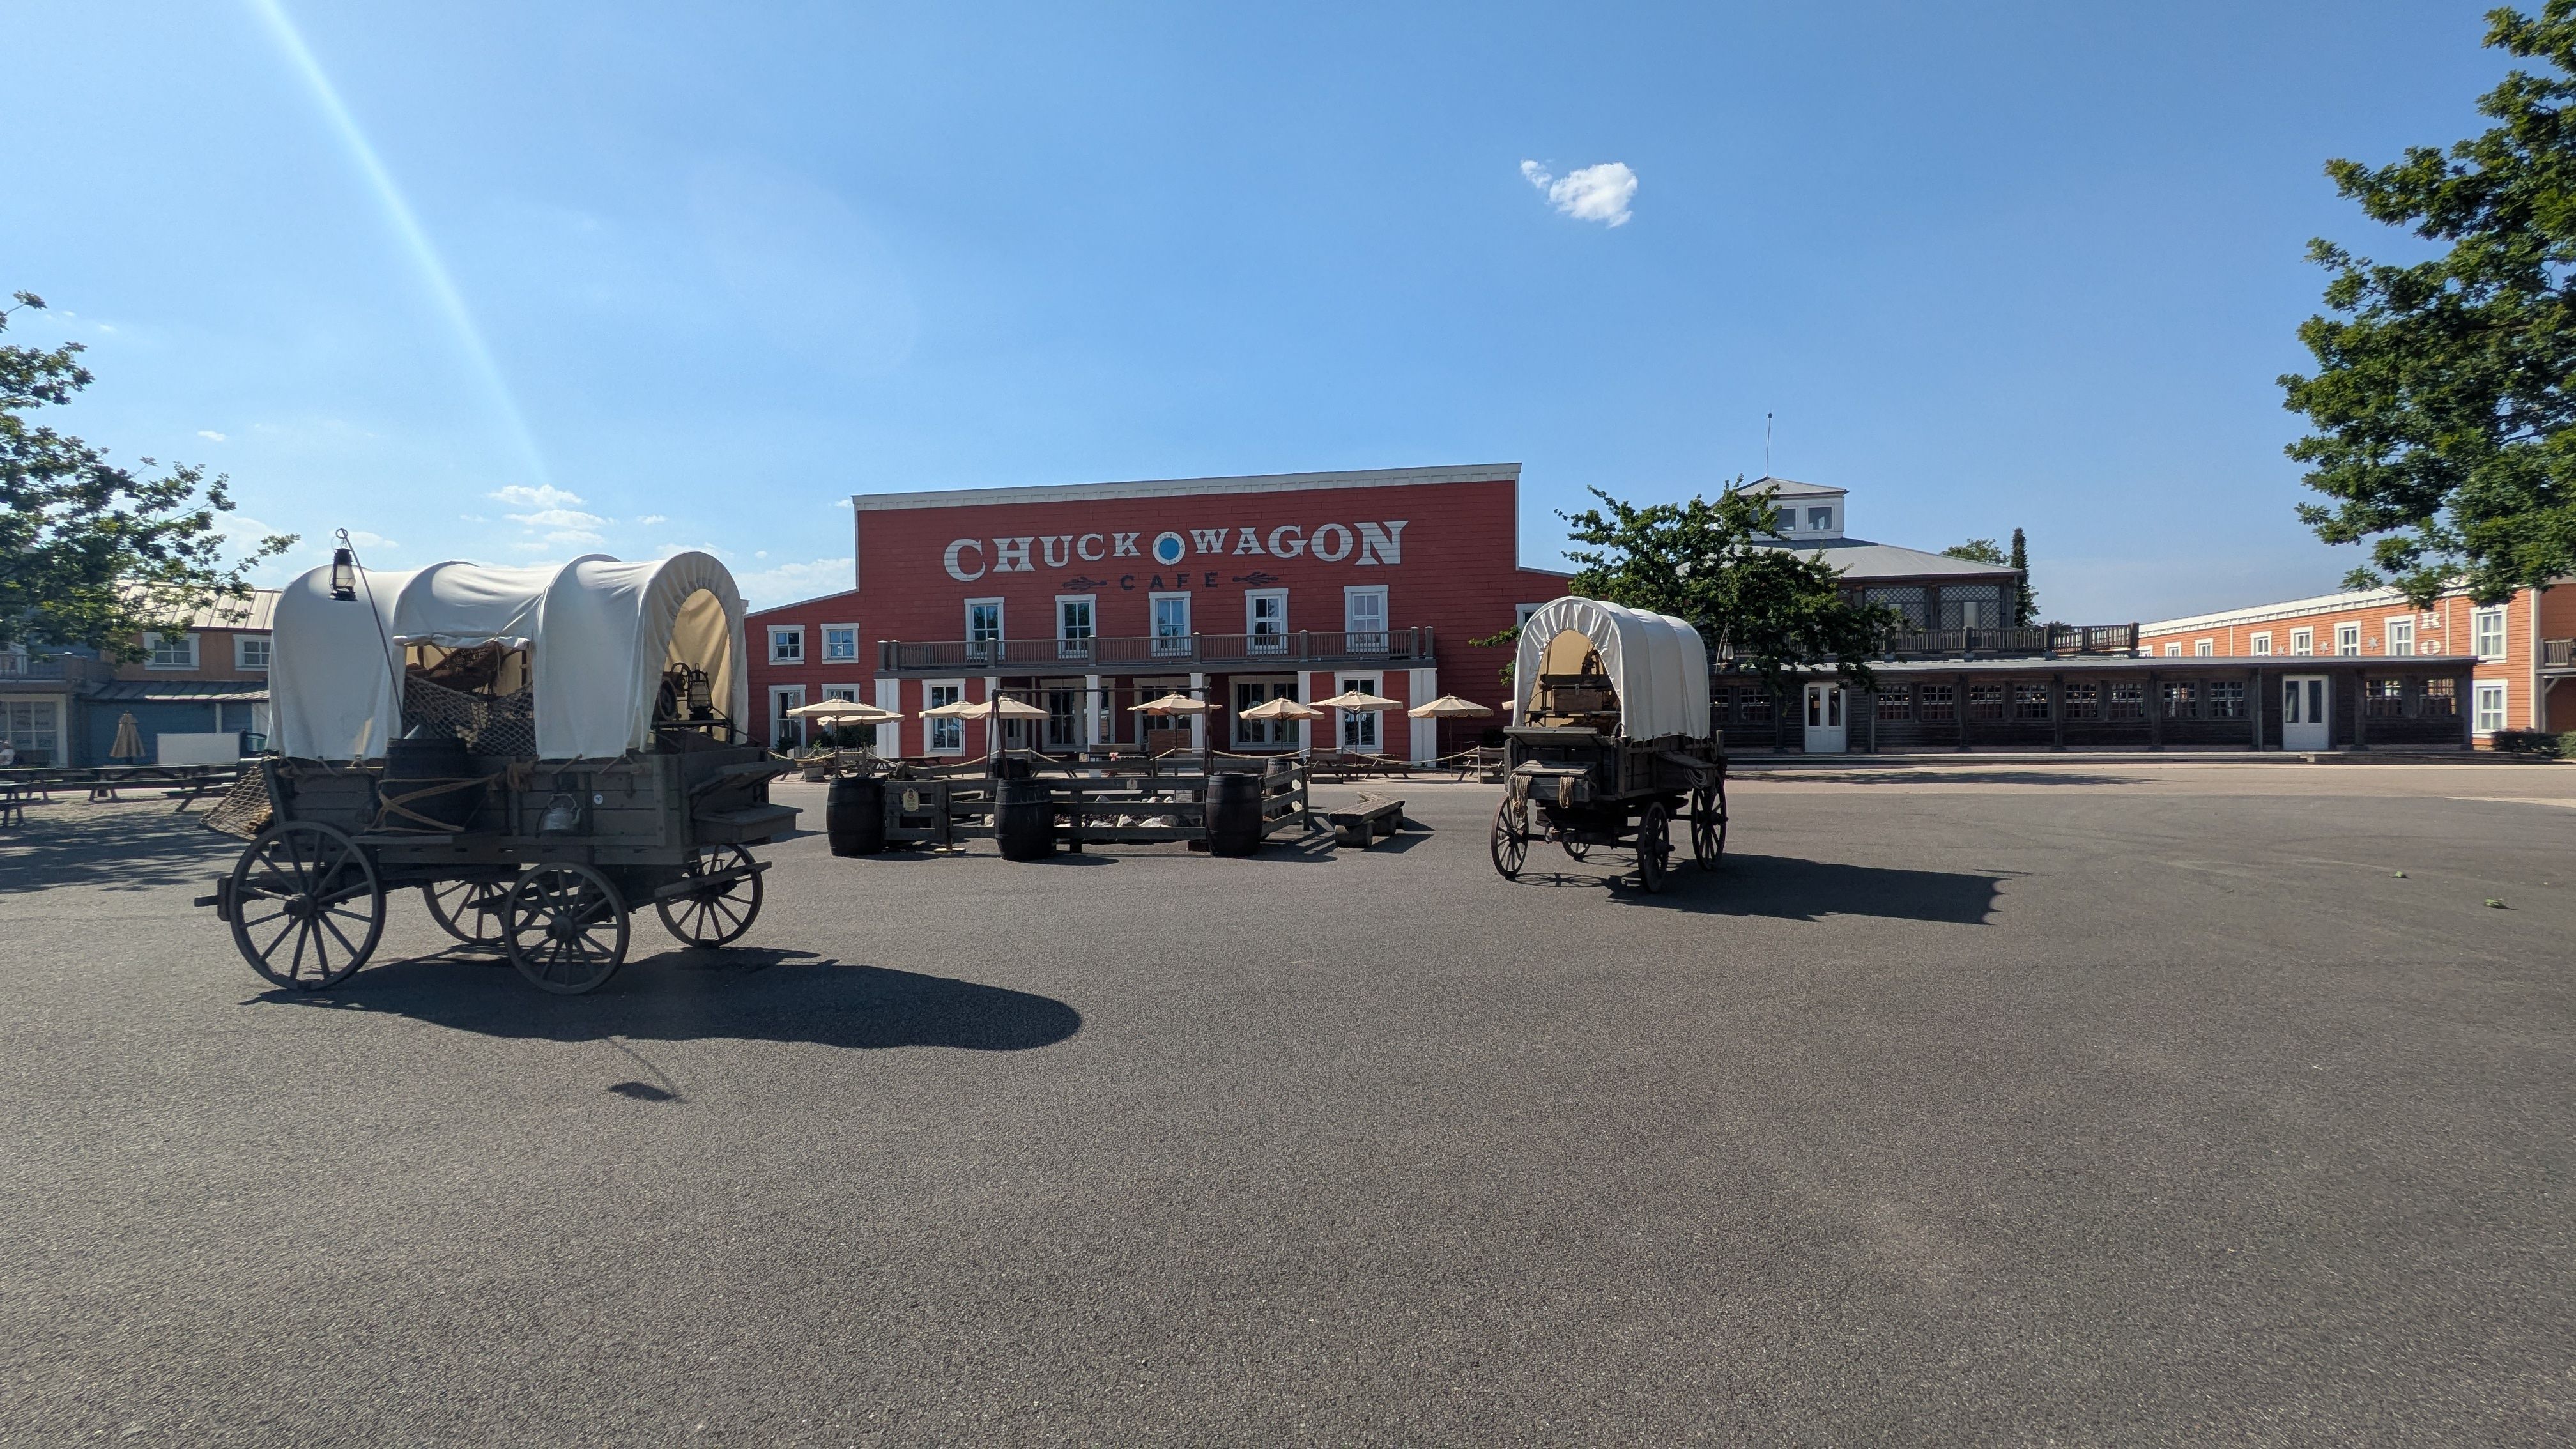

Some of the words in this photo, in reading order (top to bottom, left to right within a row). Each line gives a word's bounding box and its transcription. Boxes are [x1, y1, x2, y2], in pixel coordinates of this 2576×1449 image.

[944, 532, 1142, 582] CHUCK
[1189, 521, 1409, 566] WAGON
[1120, 572, 1218, 590] CAFE
